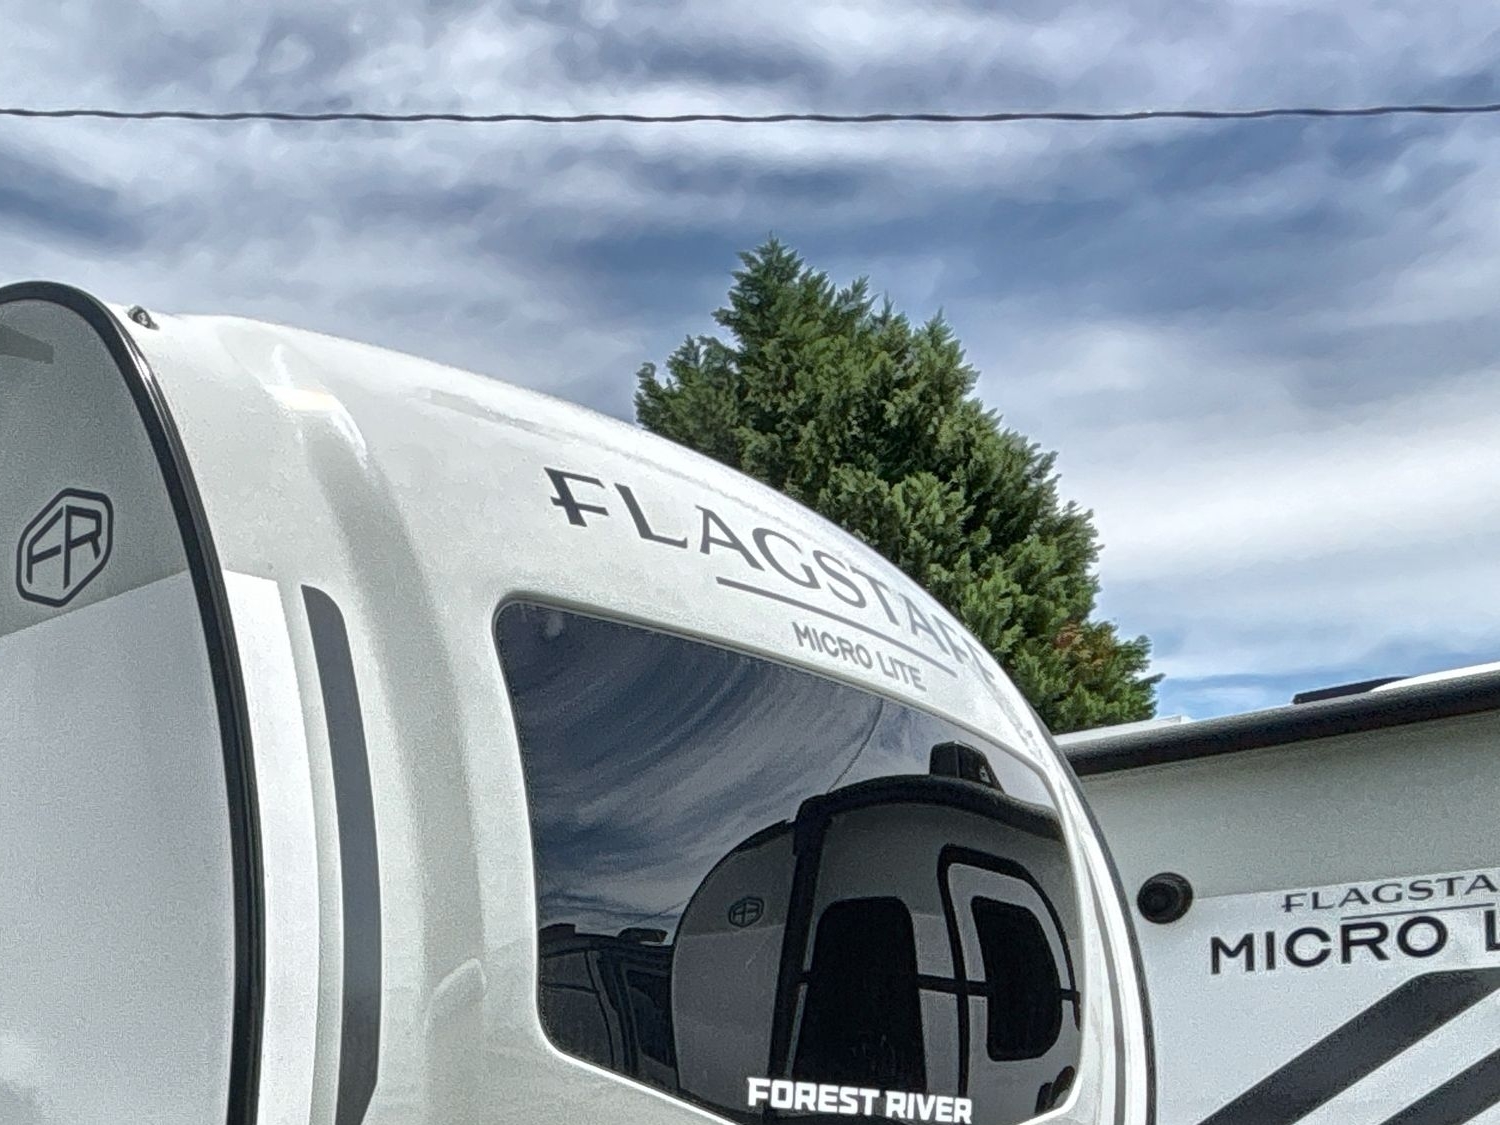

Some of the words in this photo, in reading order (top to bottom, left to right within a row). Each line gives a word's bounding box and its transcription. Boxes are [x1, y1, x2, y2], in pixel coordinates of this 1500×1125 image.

[543, 466, 997, 693] FLAGSTAFF
[791, 621, 872, 669] MICRO
[875, 649, 928, 692] LITE
[1281, 874, 1499, 913] FLAGSTA
[1210, 915, 1449, 975] MICRO
[747, 1077, 881, 1117] FOREST
[885, 1090, 973, 1125] RIVER
